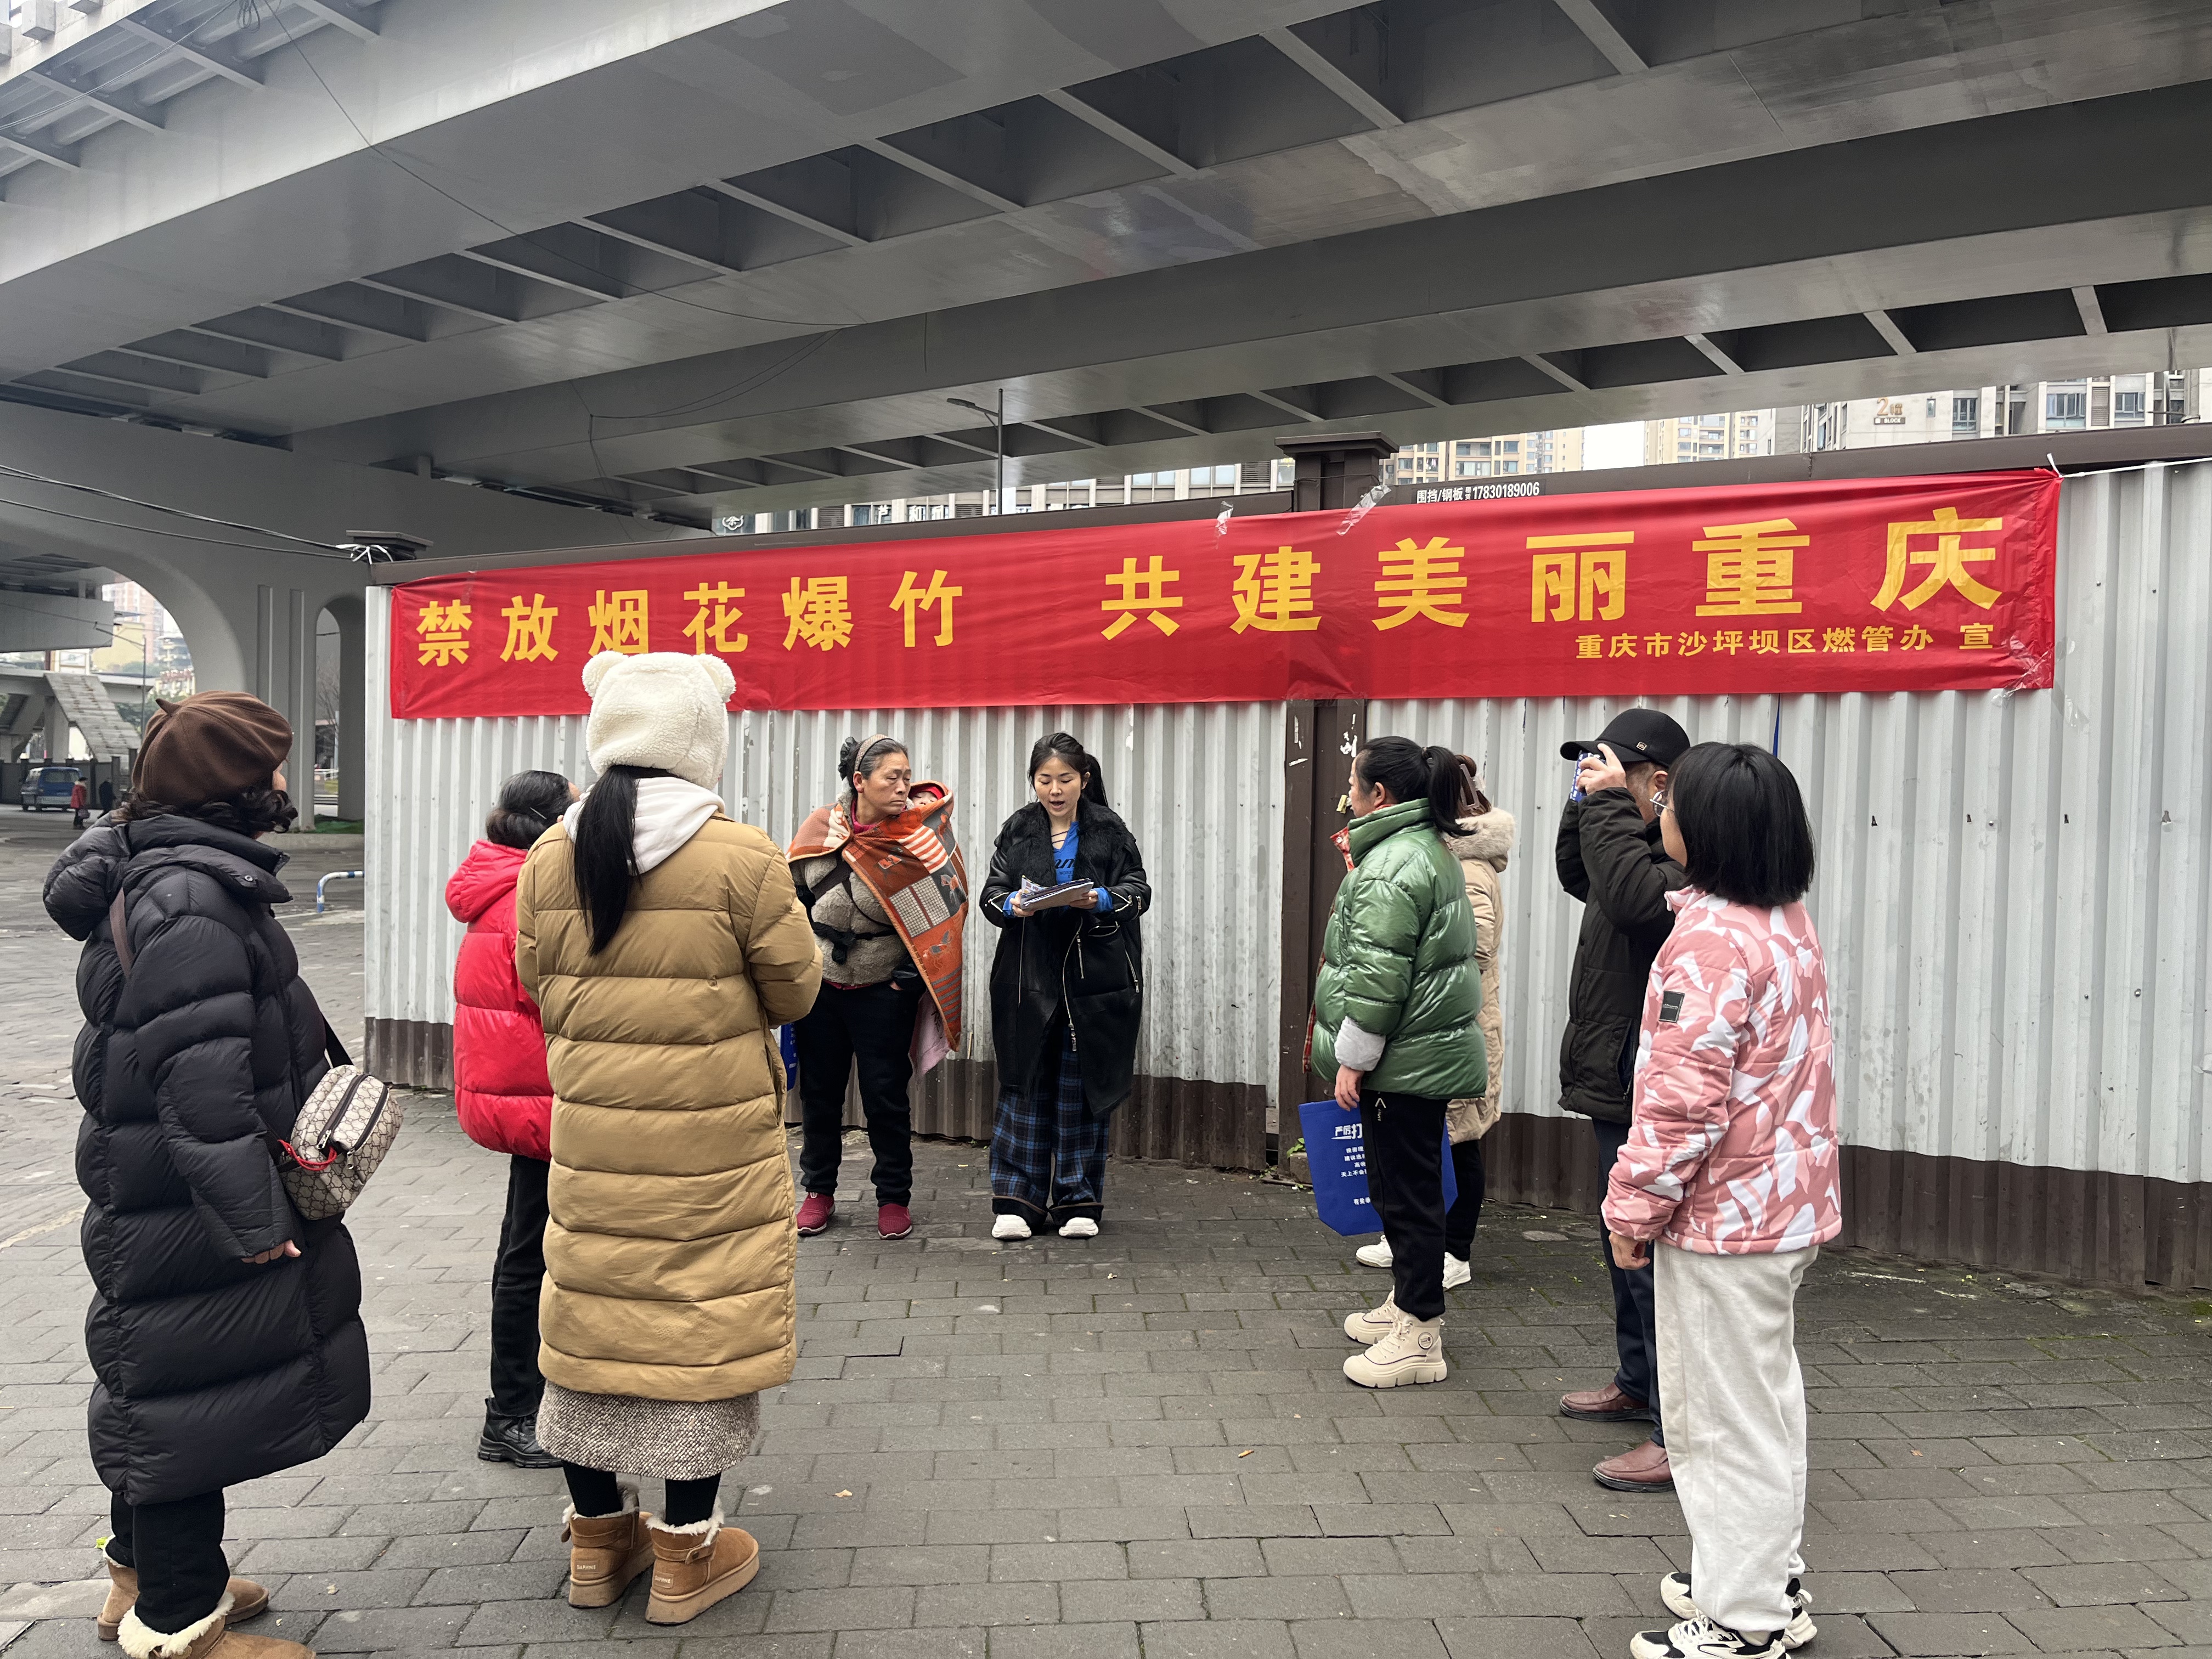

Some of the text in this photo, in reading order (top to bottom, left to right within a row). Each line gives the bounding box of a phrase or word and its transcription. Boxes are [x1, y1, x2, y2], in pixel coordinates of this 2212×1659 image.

[1472, 482, 1540, 500] 17830189006
[416, 507, 2003, 667] 禁放烟花爆竹 共建美丽重庆
[1575, 623, 1994, 659] 重庆市沙坪坝区燃管办 宣
[654, 1575, 671, 1584] DAPHNE
